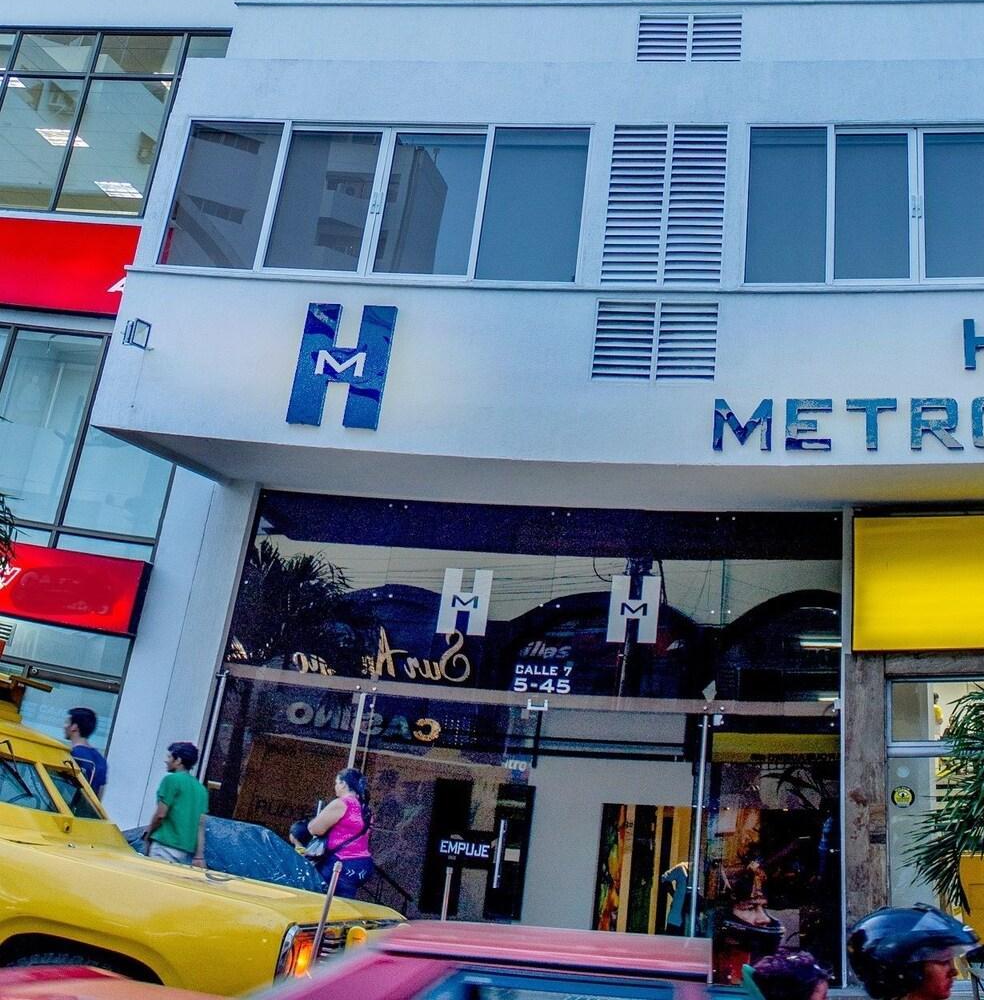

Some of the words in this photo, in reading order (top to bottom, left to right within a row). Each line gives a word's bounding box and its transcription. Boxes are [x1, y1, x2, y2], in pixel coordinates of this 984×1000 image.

[515, 664, 559, 676] CALLE
[563, 666, 573, 677] 7
[513, 677, 571, 694] 5-45
[439, 840, 490, 858] EMPUJE
